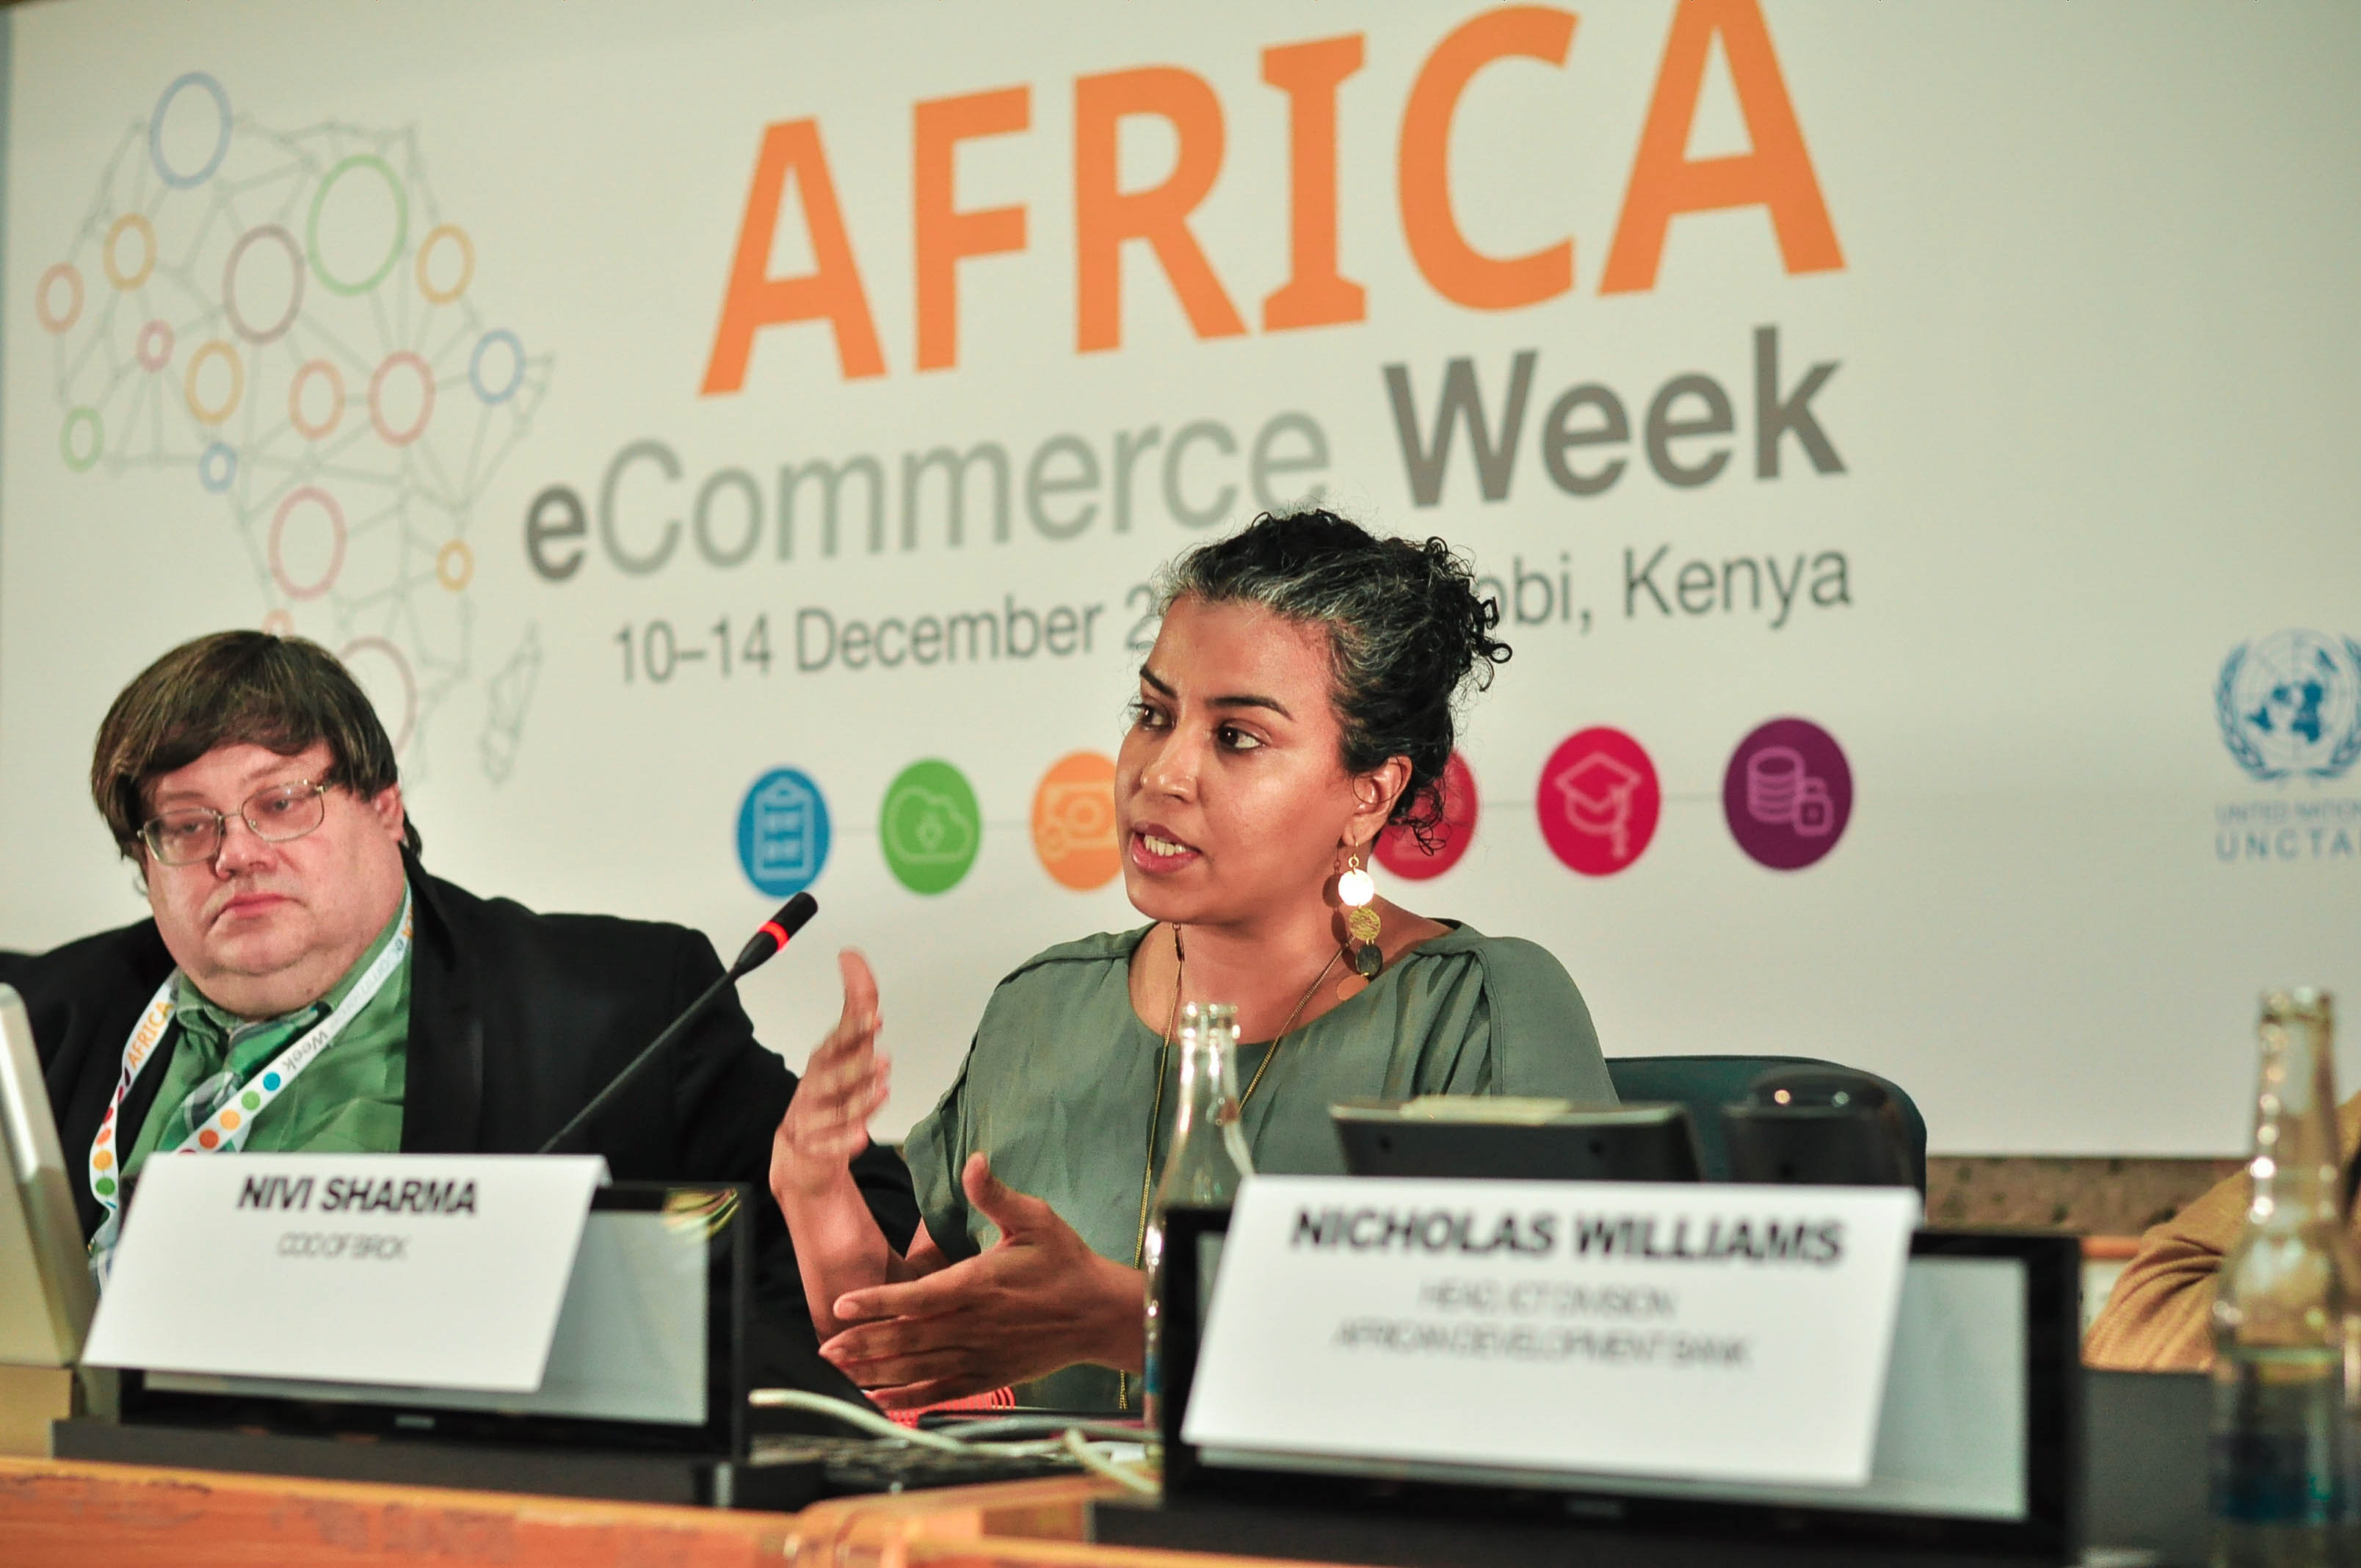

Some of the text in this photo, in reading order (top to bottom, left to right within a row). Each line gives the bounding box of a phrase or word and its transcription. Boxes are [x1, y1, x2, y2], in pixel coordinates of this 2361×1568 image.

[697, 0, 1848, 397] AFRICA
[524, 326, 1848, 583] eCommerce Week
[796, 594, 1104, 672] December
[1476, 552, 1591, 634] obi,
[1624, 544, 1852, 629] Kenya
[2215, 828, 2361, 861] UNCTA
[127, 1002, 175, 1070] AFRICA
[283, 1030, 328, 1071] Week
[236, 1175, 479, 1215] NIVI SHARMA
[1290, 1206, 1846, 1265] NICHOLAS WILLIAMS
